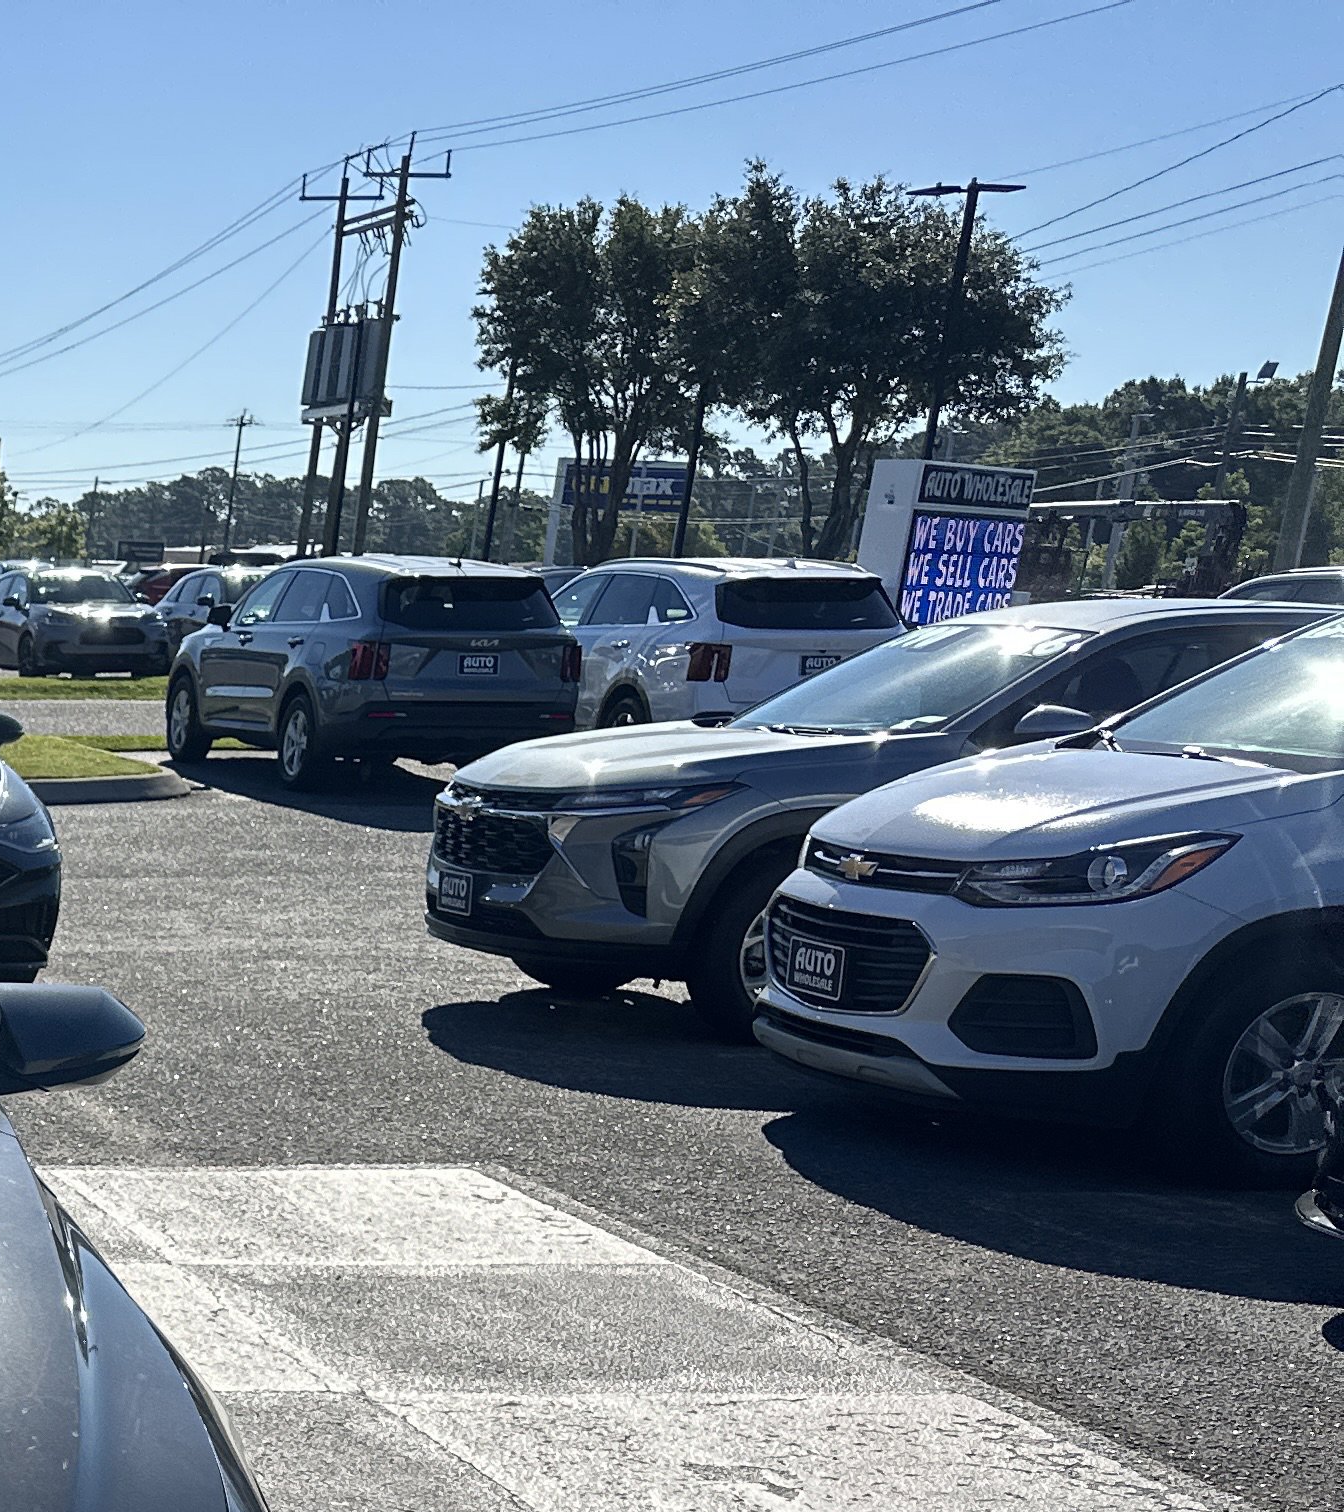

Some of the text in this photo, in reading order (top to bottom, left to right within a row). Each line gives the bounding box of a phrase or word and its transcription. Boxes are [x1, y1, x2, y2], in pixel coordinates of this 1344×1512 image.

[925, 471, 1032, 504] AUTO WHOLESALE
[914, 516, 1025, 554] WE BUY CARS
[907, 552, 1018, 589] WE SELL CARS
[901, 589, 923, 622] WE
[463, 656, 495, 668] AUTO
[805, 657, 837, 669] AUTO
[442, 876, 468, 898] AUTO
[795, 947, 836, 977] AUTO
[793, 970, 834, 992] WHOLESALE
